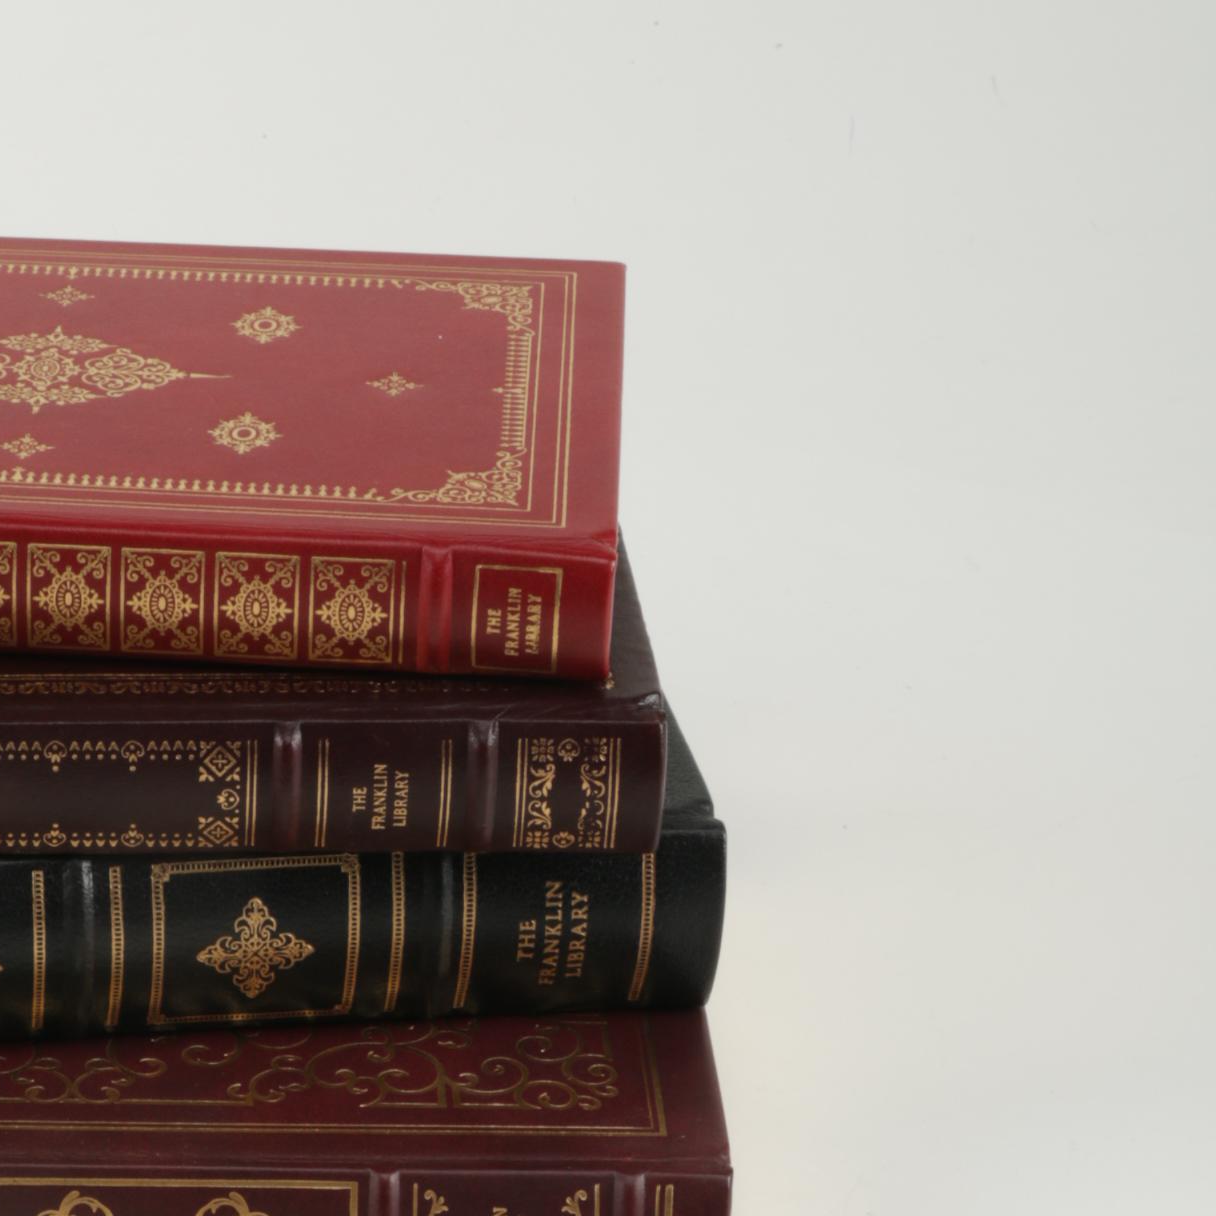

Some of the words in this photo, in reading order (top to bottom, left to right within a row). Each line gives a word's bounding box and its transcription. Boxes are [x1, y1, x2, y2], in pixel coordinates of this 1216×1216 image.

[486, 608, 502, 634] THE
[504, 587, 522, 656] FRANKLIN
[352, 786, 367, 813] THE
[371, 764, 388, 830] FRANKLIN
[393, 770, 410, 827] LIBRARY
[517, 919, 536, 962] THE
[538, 881, 563, 985] FRANKLIN
[565, 891, 589, 977] LIBRARY
